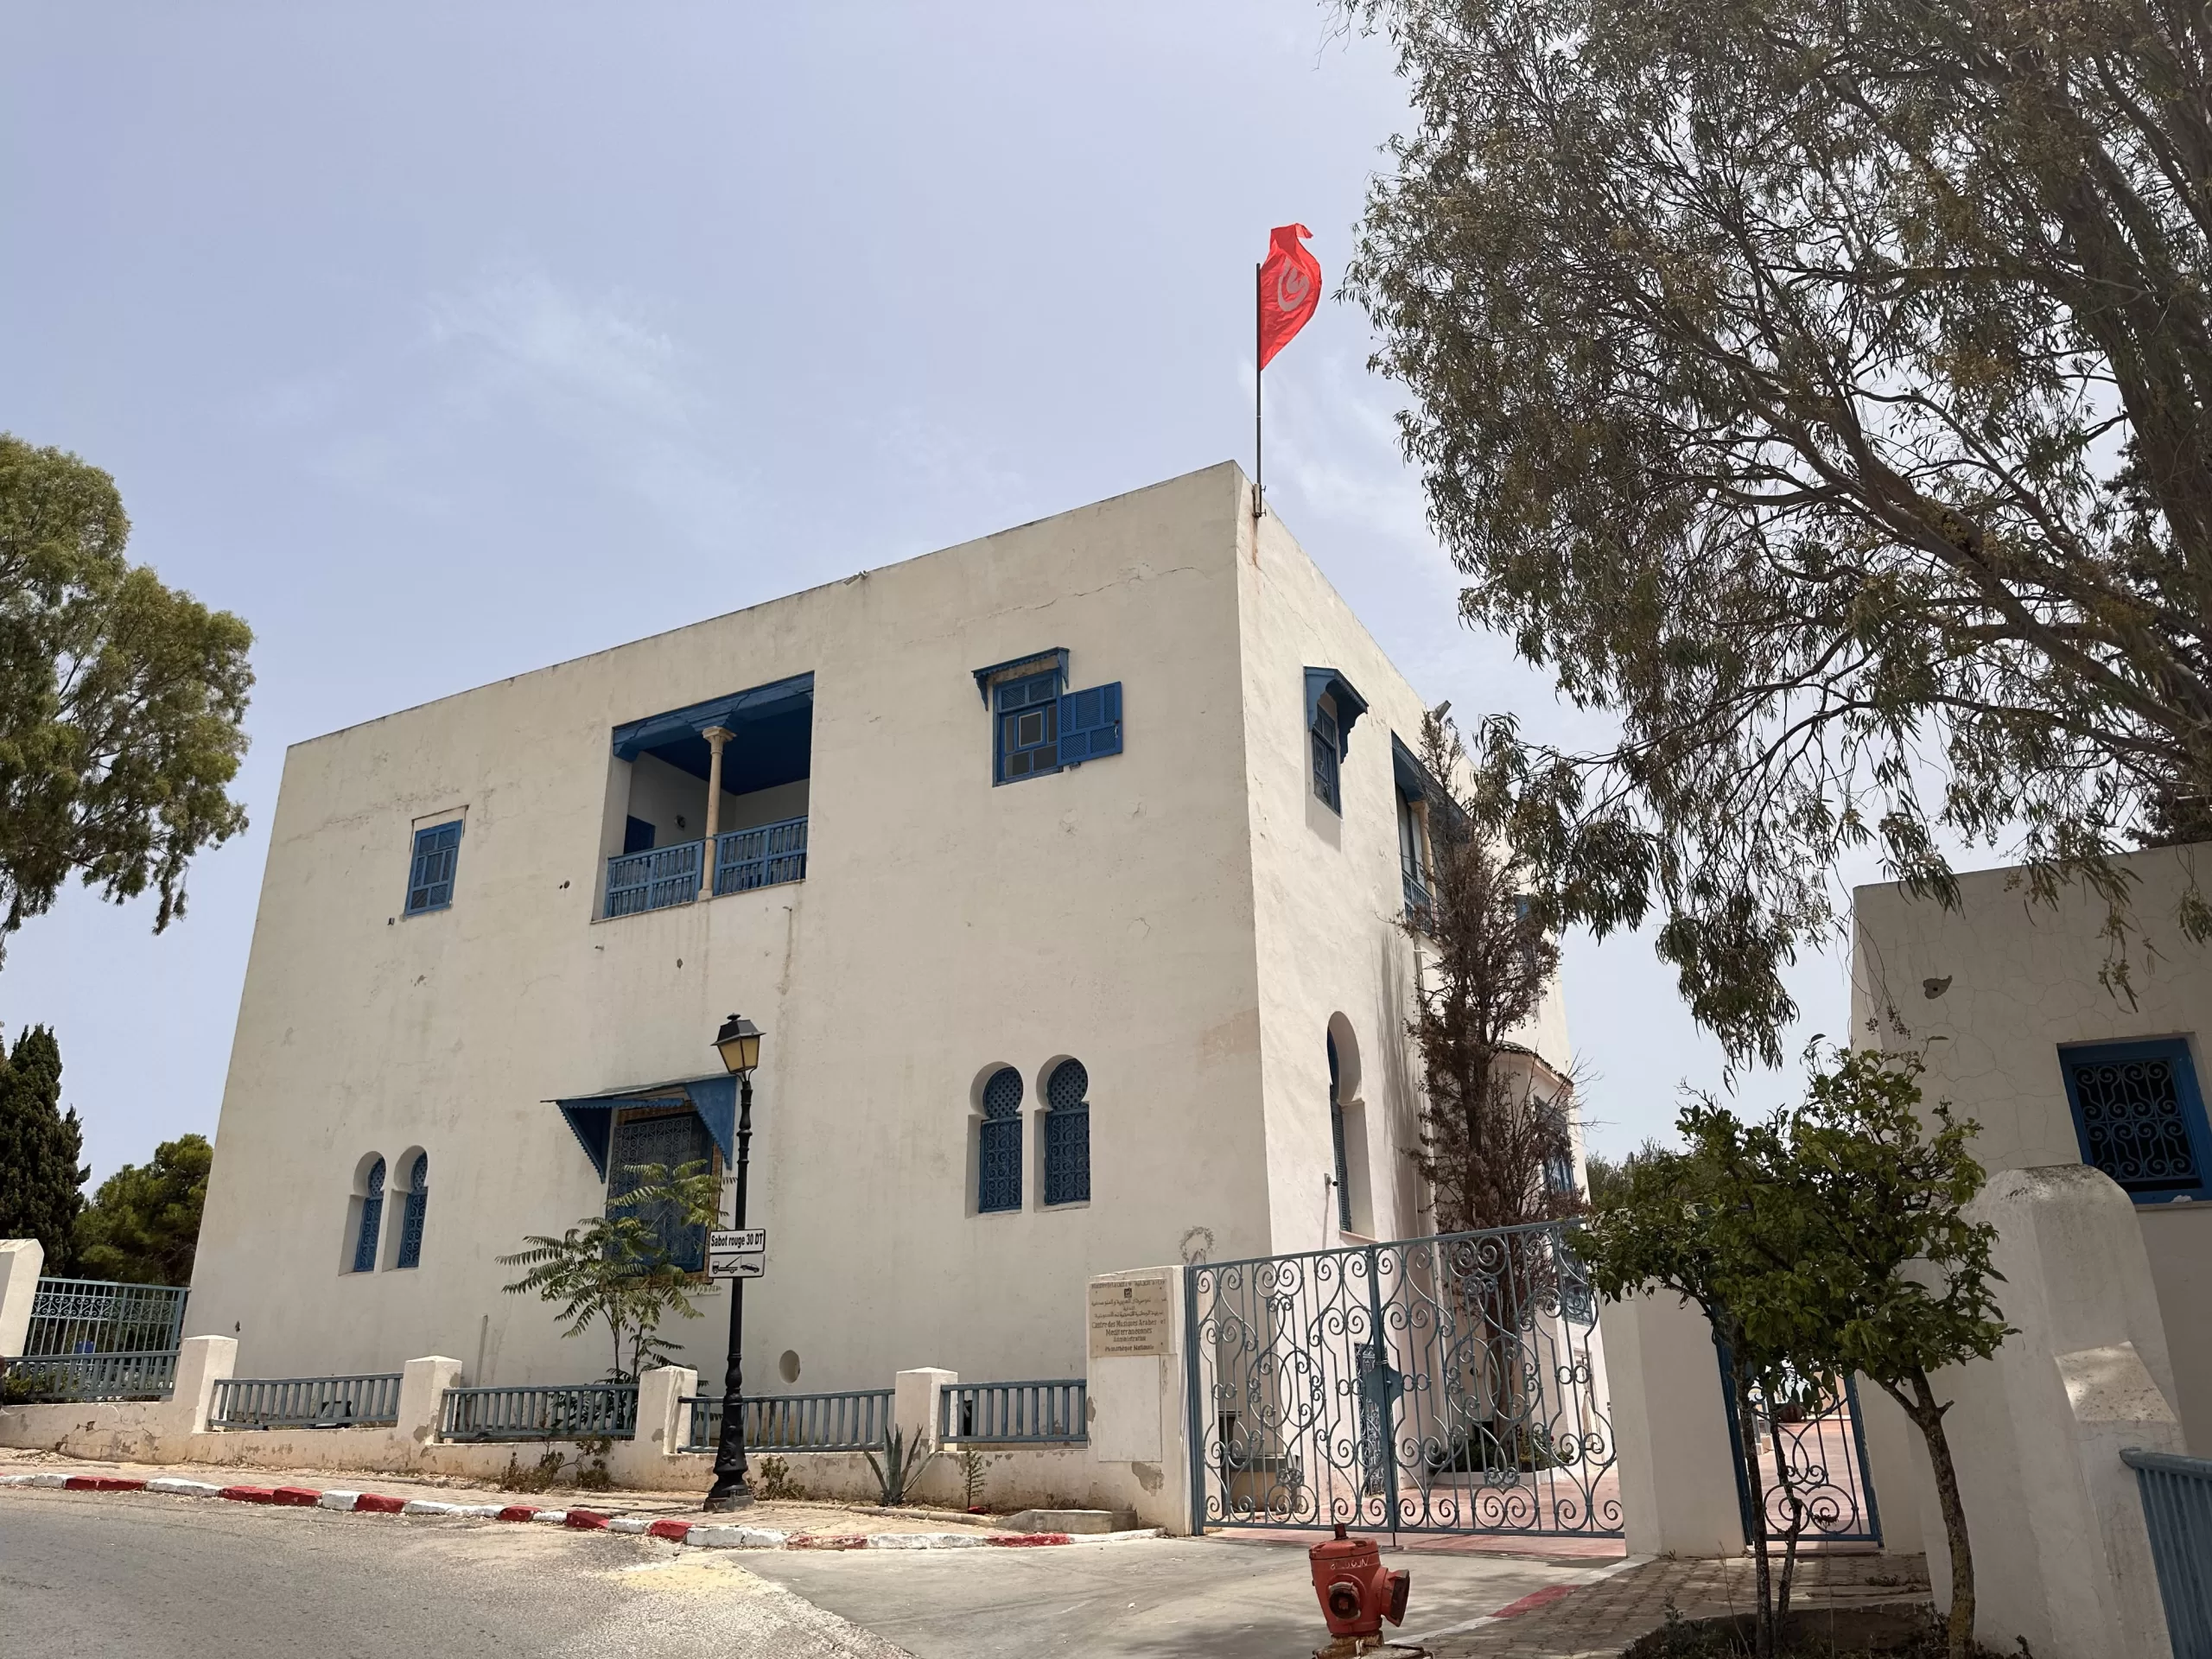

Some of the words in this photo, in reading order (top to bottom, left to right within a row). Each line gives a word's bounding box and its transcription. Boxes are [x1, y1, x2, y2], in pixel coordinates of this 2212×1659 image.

[711, 1235, 728, 1247] Sabot
[728, 1236, 745, 1249] rouge
[747, 1233, 753, 1245] 30
[755, 1233, 763, 1245] DT
